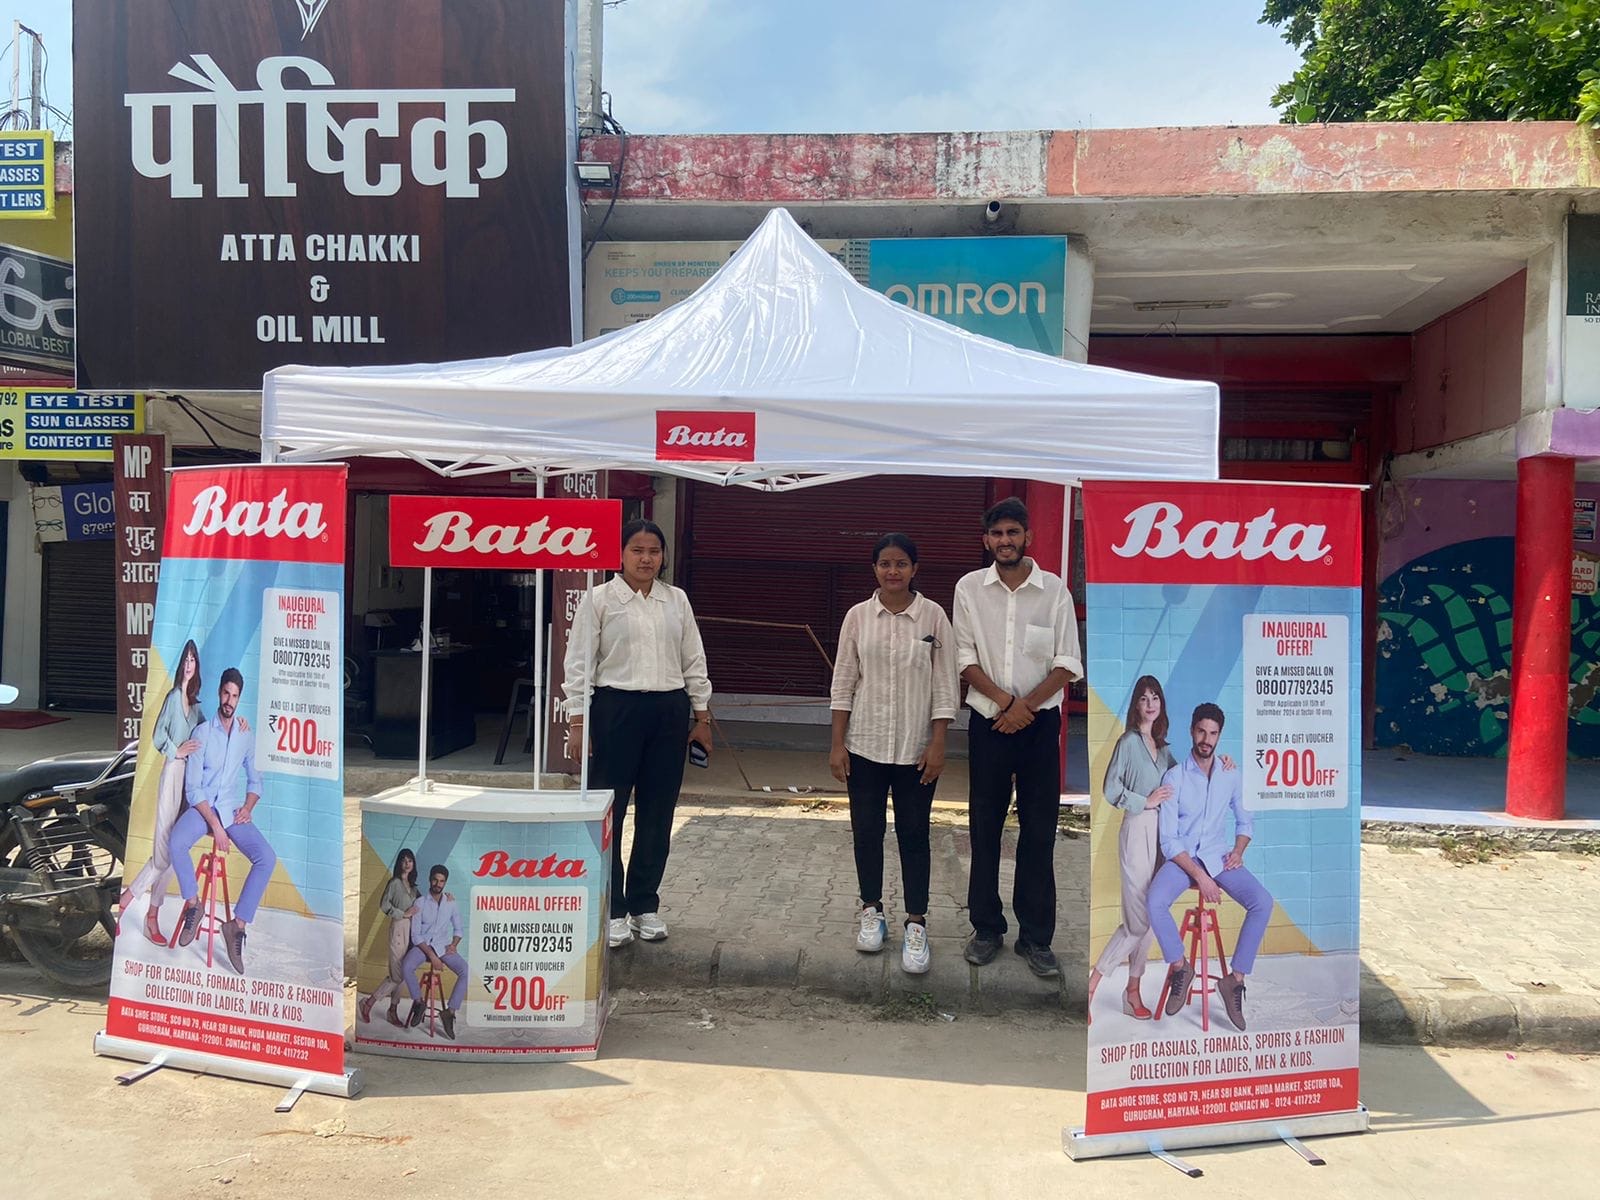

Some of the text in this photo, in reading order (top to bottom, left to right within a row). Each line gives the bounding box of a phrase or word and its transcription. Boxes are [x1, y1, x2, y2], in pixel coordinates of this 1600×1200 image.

[124, 54, 516, 198] पौष्टिक
[12, 193, 42, 207] LENS
[220, 234, 420, 262] ATTA CHAKKI
[605, 268, 639, 278] KEEPS
[641, 268, 662, 277] YOU
[309, 275, 330, 303] &
[256, 315, 385, 344] OIL MILL
[42, 336, 70, 354] BEST
[30, 396, 68, 407] EYE
[77, 395, 127, 407] TEST
[31, 415, 129, 427] SUN GLASSES
[29, 436, 91, 447] CONTECT
[663, 425, 747, 447] Bata
[124, 445, 152, 478] MP
[74, 491, 115, 515] Glo
[128, 491, 151, 512] का
[183, 485, 327, 539] Bata
[413, 510, 597, 556] Bata
[1111, 502, 1331, 561] Bata
[278, 595, 325, 613] INAUGURAL
[127, 603, 153, 635] MP
[286, 613, 317, 630] OFFER!
[1262, 621, 1327, 638] INAUGURAL
[1277, 640, 1313, 656] OFFER!
[273, 650, 330, 669] 08007792345
[1255, 666, 1334, 676] GIVE A MISSED CALL ON
[1256, 679, 1333, 695] 08007792345
[1256, 733, 1334, 744] AND GET A GIFT VOUCHER
[472, 850, 587, 878] Bata
[476, 895, 582, 911] INAUGURAL OFFER!
[483, 923, 573, 934] GIVE A MISSED CALL ON
[483, 936, 573, 952] 08007792345
[485, 962, 565, 971] AND GET A GIFT VOUCHER
[124, 960, 334, 1007] SHOP FOR CASUALS, FORMALS, SPORTS & FASHION
[145, 984, 305, 1022] COLLECTION FOR LADIES, MEN & KIDS.
[121, 1006, 133, 1016] BATA
[134, 1008, 149, 1020] SHOE
[202, 1020, 217, 1032] NEAR
[218, 1022, 228, 1033] SBI
[293, 1035, 315, 1047] SECTOR
[225, 1037, 251, 1050] CONTACT
[1101, 1028, 1344, 1064] SHOP FOR CASUALS, FORMALS, SPORTS & FASHION
[1130, 1051, 1315, 1080] COLLECTION FOR LADIES, MEN & KIDS.
[1101, 1098, 1117, 1110] BATA
[1118, 1096, 1136, 1108] SHOE
[1138, 1093, 1161, 1106] STORE,
[1163, 1092, 1176, 1103] SCO
[1178, 1091, 1187, 1102] NO
[1202, 1088, 1219, 1099] NEAR
[1220, 1087, 1232, 1098] SBI
[1255, 1084, 1273, 1095] HUDA
[1274, 1081, 1303, 1093] MARKET,
[1304, 1078, 1327, 1090] SECTOR
[1123, 1108, 1166, 1122] GURUGRAM,
[1230, 1099, 1259, 1112] CONTACT
[1260, 1098, 1269, 1109] NO
[1275, 1093, 1321, 1107] 0124-4117232
